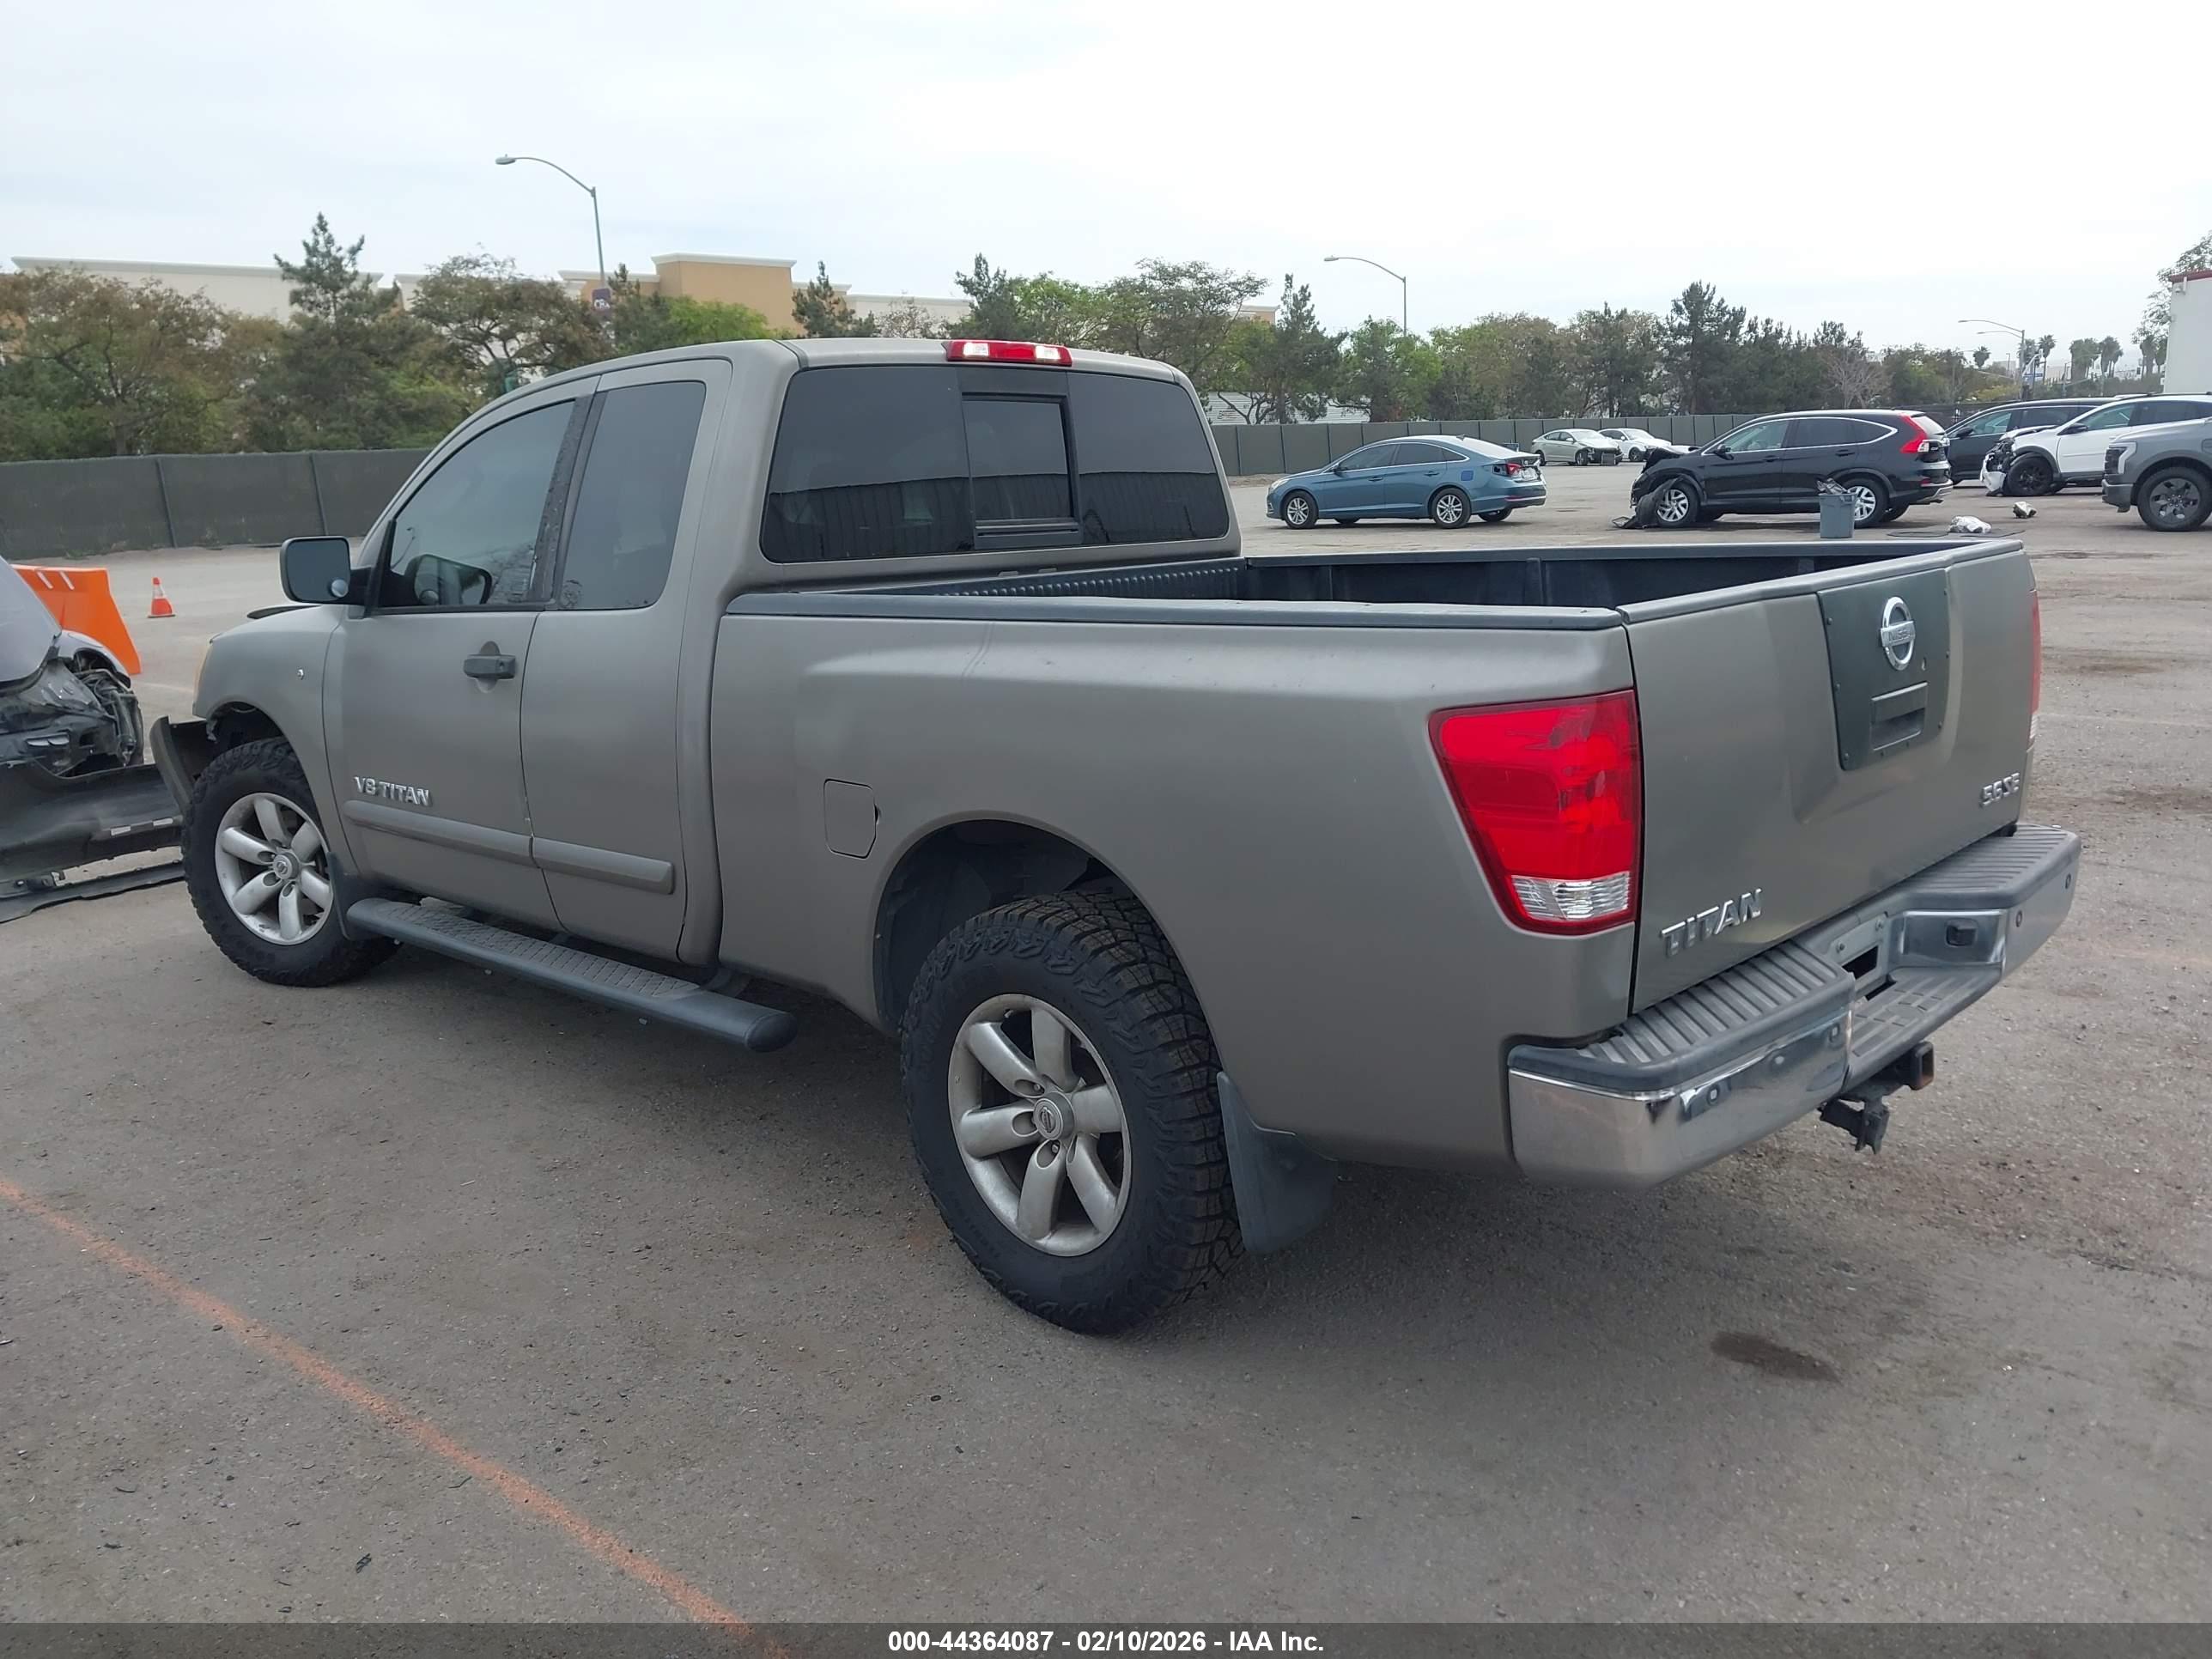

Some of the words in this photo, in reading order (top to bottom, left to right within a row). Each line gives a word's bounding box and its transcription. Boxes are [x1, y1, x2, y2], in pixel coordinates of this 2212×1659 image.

[354, 776, 376, 795] V8
[379, 781, 430, 806] TITAN
[1661, 888, 1762, 955] TITAN
